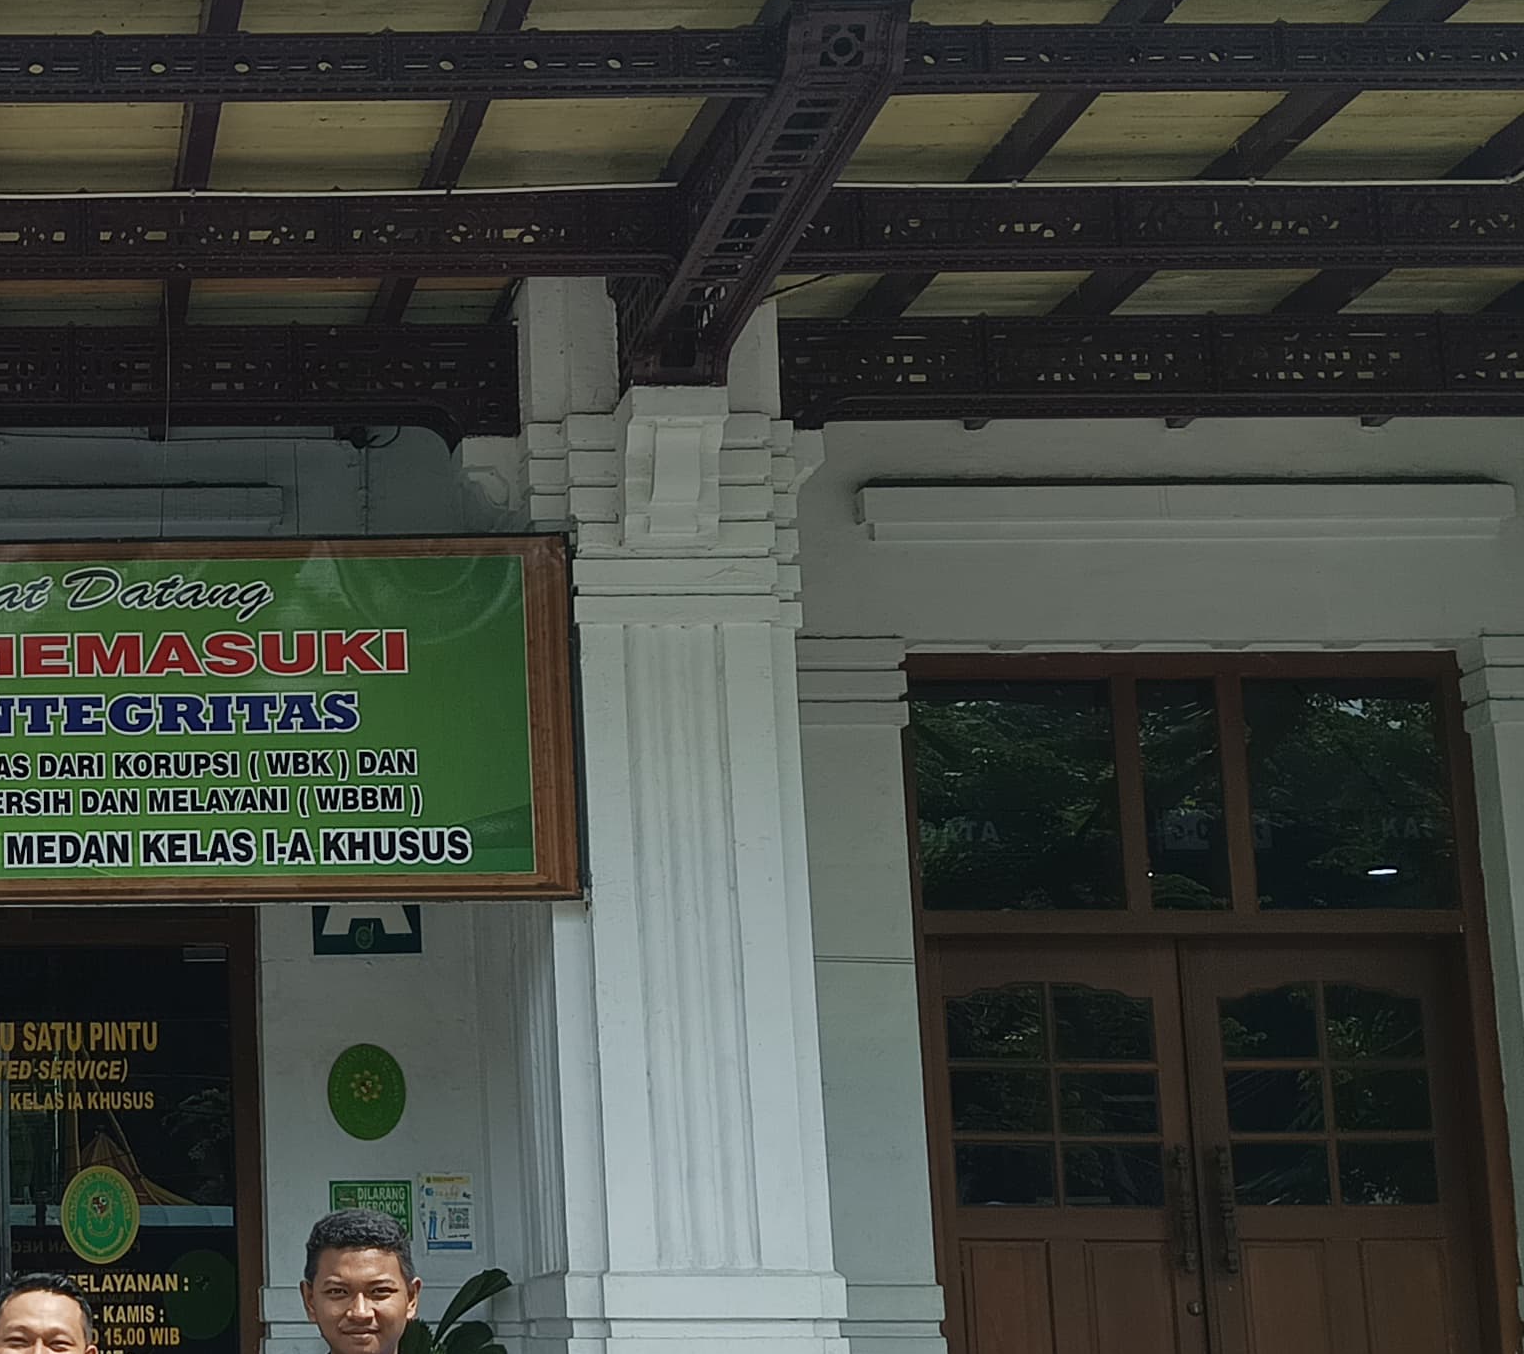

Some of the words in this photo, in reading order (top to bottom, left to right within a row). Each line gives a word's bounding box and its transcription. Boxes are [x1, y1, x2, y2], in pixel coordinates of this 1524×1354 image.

[63, 567, 274, 622] Datang
[39, 753, 105, 779] DARI
[113, 751, 239, 778] KORUPSI
[357, 750, 418, 776] DAN
[80, 789, 138, 815] DAN
[147, 787, 289, 815] MELAYANI
[3, 832, 132, 869] MEDAN
[140, 830, 258, 867] KELAS
[262, 829, 316, 865] I-A
[320, 827, 473, 865] KHUSUS
[23, 1021, 82, 1051] SATU
[90, 1021, 157, 1051] PINTU
[10, 1092, 64, 1110] KELAS
[68, 1092, 83, 1110] IA
[88, 1091, 155, 1110] KHUSUS
[357, 1187, 405, 1199] DILARANG
[103, 1305, 156, 1323] KAMIS
[103, 1327, 146, 1346] 15.00
[150, 1327, 180, 1346] WIB
